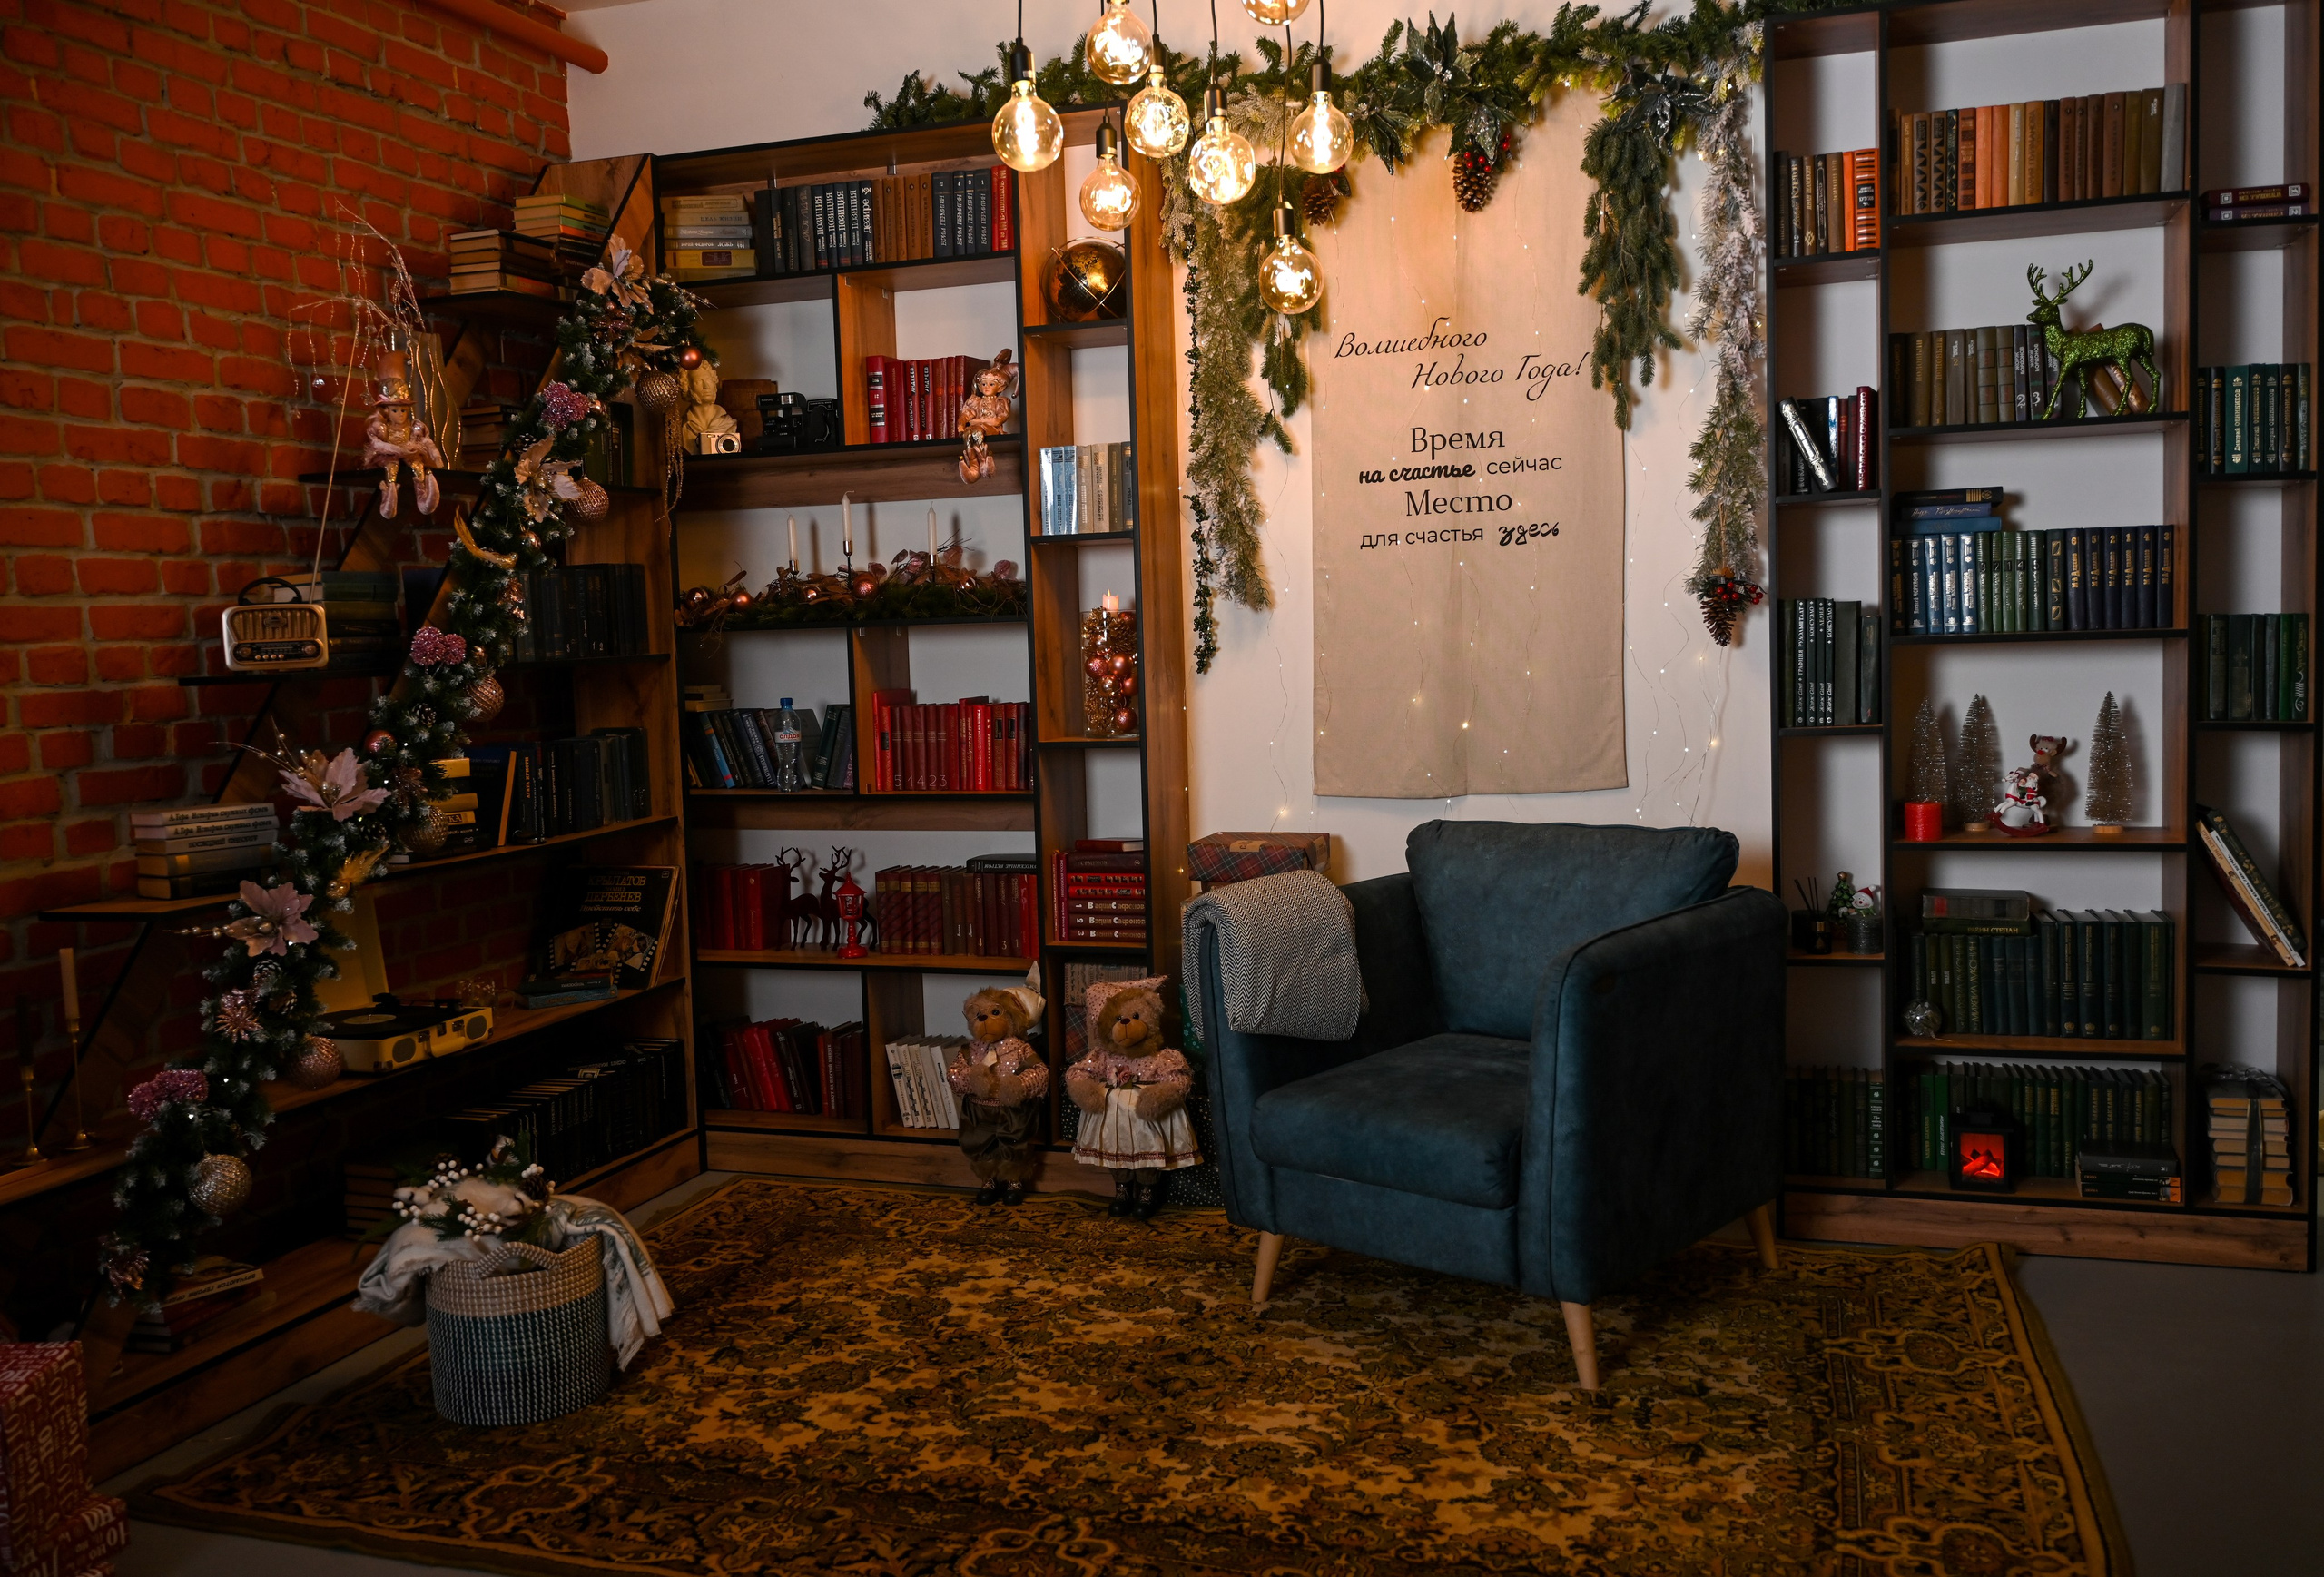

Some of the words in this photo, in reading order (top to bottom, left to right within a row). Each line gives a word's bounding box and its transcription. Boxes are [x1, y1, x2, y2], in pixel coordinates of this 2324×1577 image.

[815, 196, 824, 235] ПОЗИЦИЯ
[826, 192, 835, 232] ПОЗИЦИЯ
[837, 190, 846, 231] ПОЗИЦИЯ
[850, 190, 858, 229] ПОЗИЦИЯ
[1334, 317, 1487, 358] Волшебного
[1412, 354, 1504, 389] Нового
[1515, 352, 1590, 401] Года!
[1410, 427, 1506, 460] Время
[1359, 468, 1385, 483] на
[1389, 463, 1476, 483] счастье
[1486, 455, 1562, 475] сейчас
[1405, 489, 1512, 517] Место
[1360, 532, 1398, 549] для
[1405, 527, 1484, 545] счастья
[1498, 522, 1560, 546] здесь
[2071, 536, 2077, 545] 6
[2092, 535, 2097, 543] 5
[2110, 534, 2116, 543] 2
[2126, 533, 2131, 542] 1
[2143, 533, 2150, 542] 4
[2164, 531, 2169, 540] 3
[894, 775, 902, 787] 5
[908, 775, 914, 787] 1
[917, 775, 926, 787] 4
[929, 775, 937, 787] 2
[940, 775, 947, 787] 3
[587, 876, 647, 886] КРЫЛАТОВ
[585, 892, 642, 903] ДЕРБЕНЕВ
[978, 938, 982, 946] 4
[1002, 940, 1007, 950] 3
[1015, 939, 1019, 947] 1
